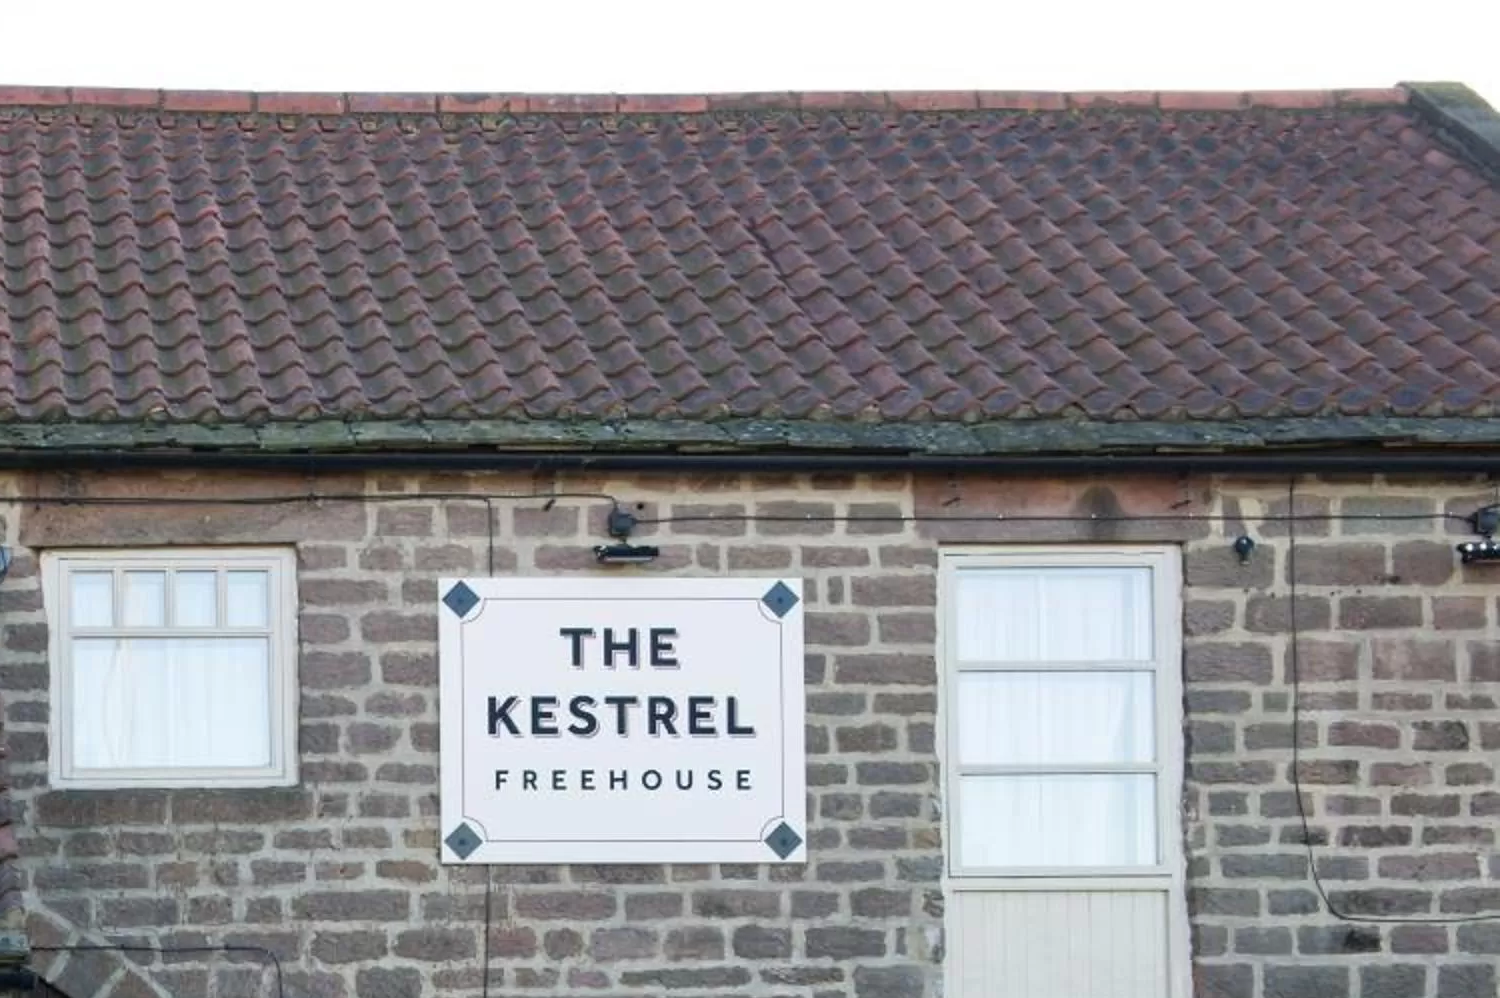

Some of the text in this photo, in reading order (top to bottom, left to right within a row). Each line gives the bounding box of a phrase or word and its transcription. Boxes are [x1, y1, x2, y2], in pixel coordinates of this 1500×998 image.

[559, 627, 680, 669] THE
[486, 695, 756, 738] KESTREL
[494, 769, 752, 791] FREEHOUSE
